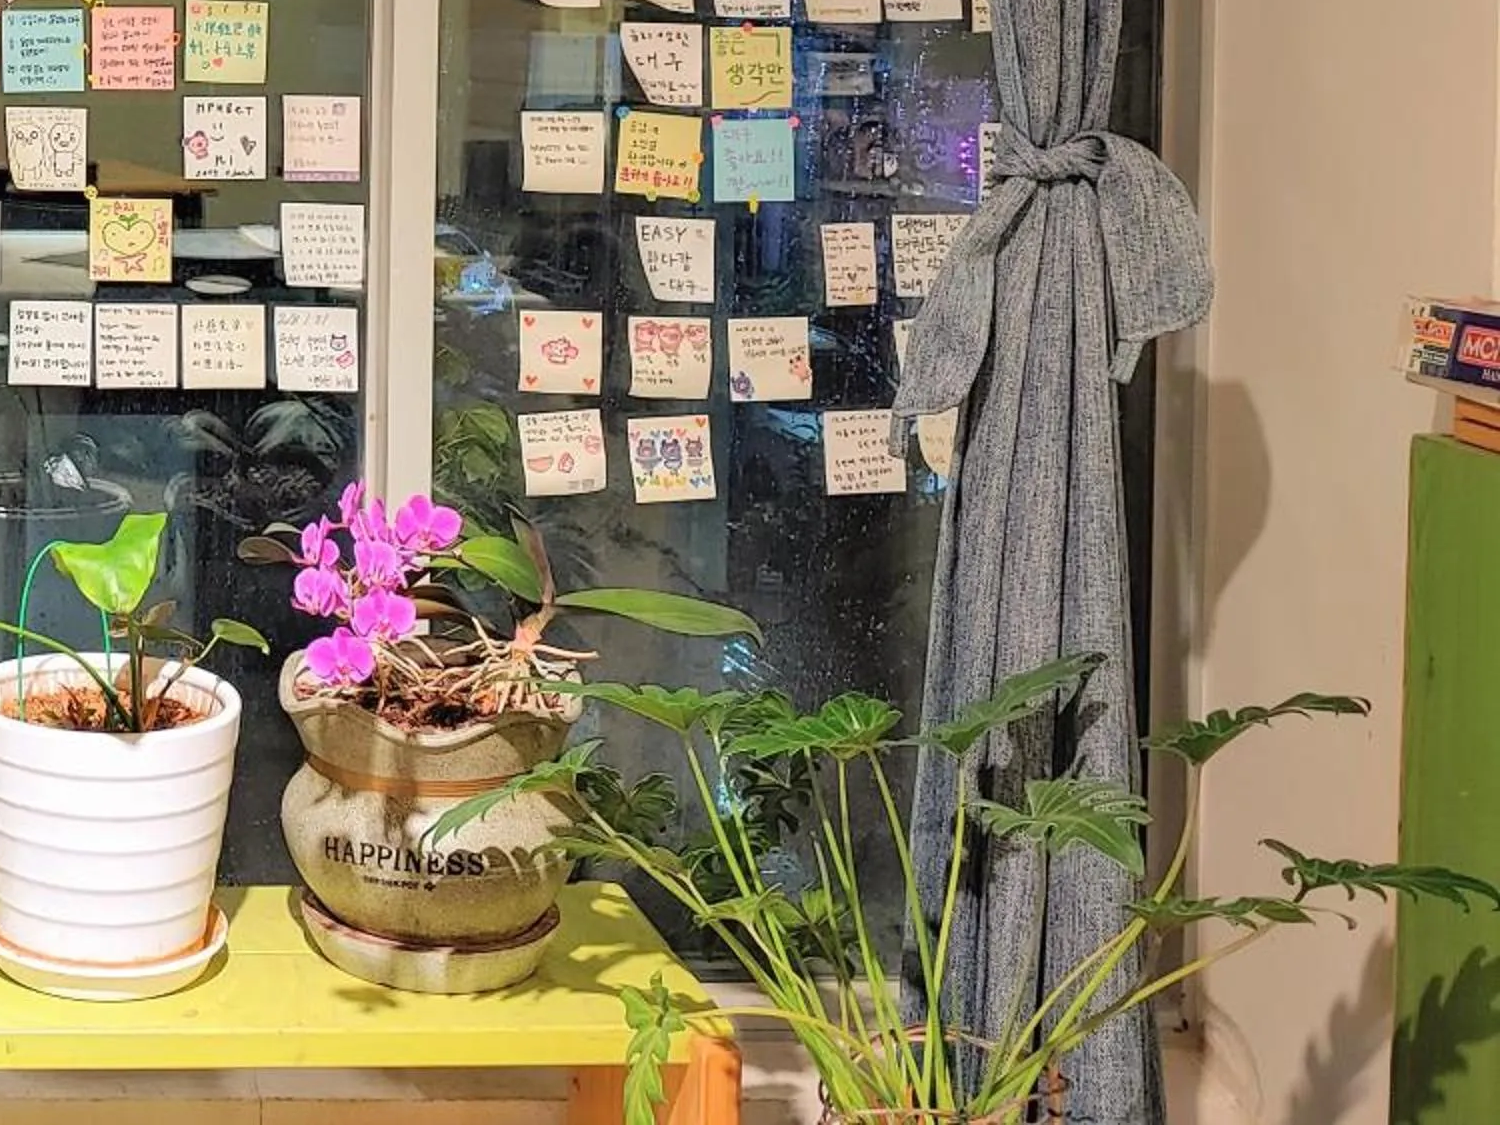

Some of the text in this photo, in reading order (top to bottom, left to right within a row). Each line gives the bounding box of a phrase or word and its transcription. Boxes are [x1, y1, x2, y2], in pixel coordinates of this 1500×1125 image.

[724, 63, 785, 87] 생각만
[641, 224, 688, 245] EASY
[324, 836, 486, 876] HAPPINESS
